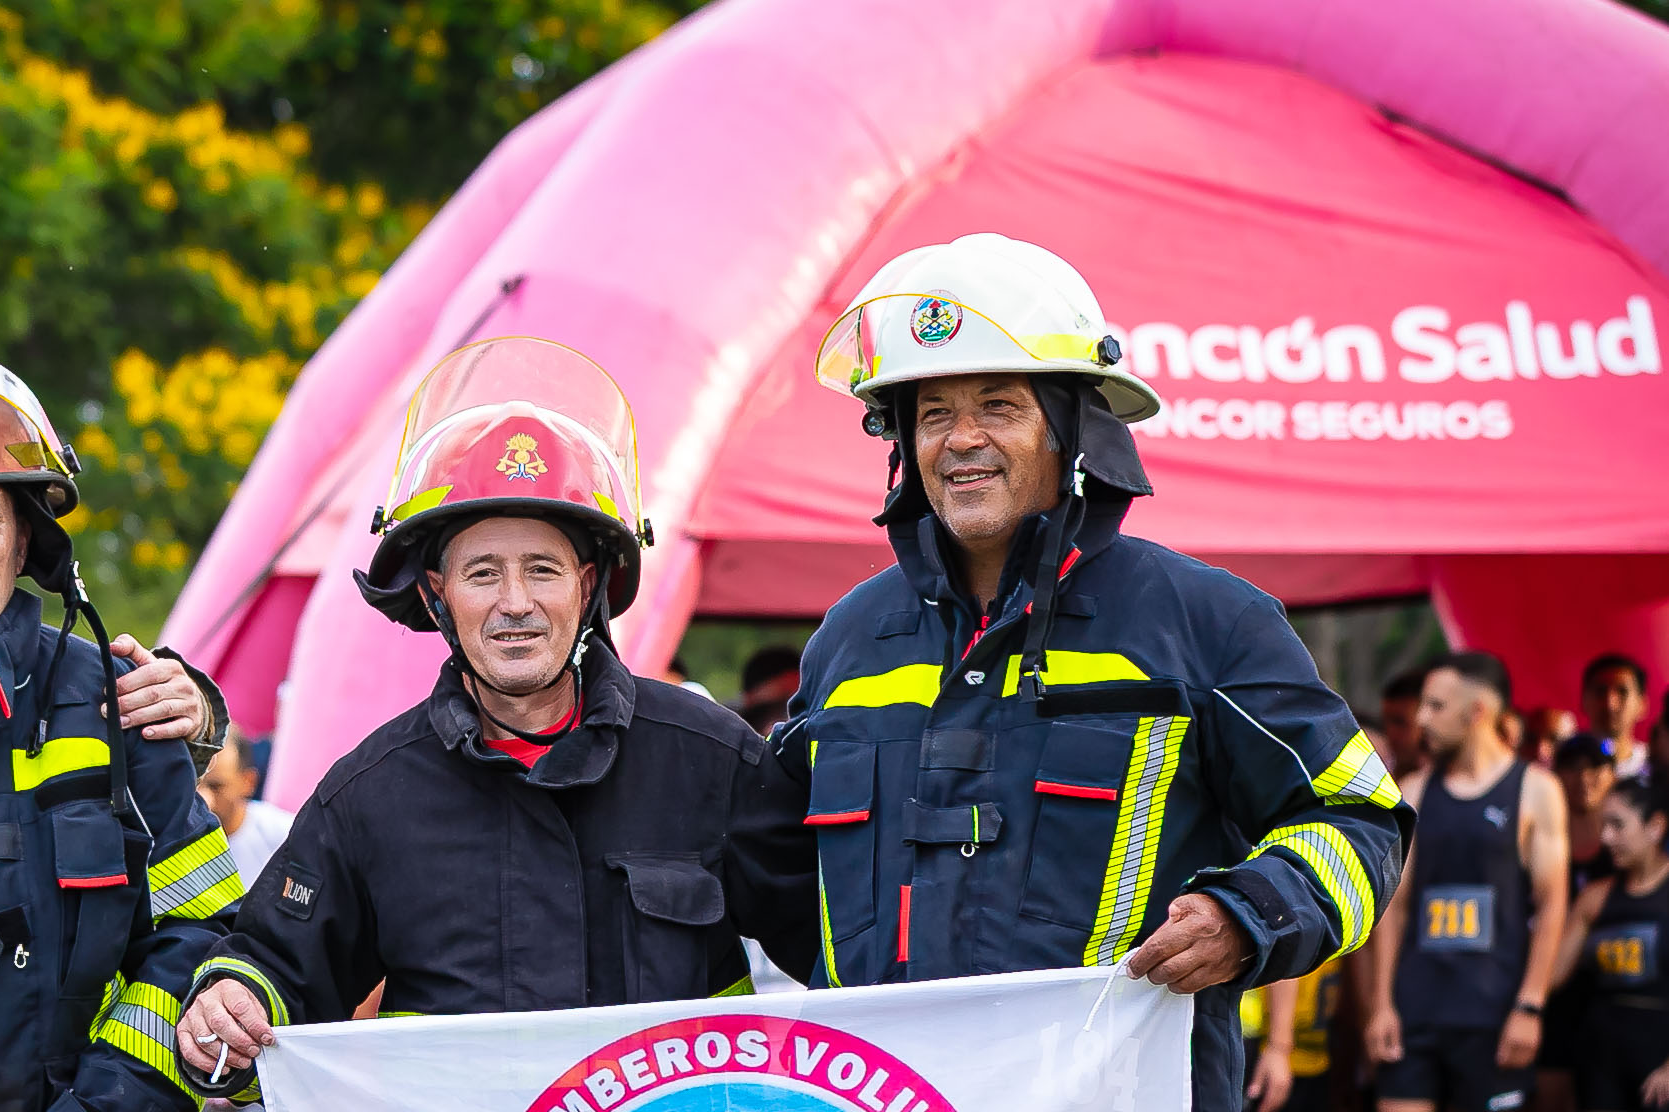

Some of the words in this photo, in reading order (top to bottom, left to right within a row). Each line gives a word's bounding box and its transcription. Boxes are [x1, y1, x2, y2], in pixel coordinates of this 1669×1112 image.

[1105, 317, 1387, 382] nción
[1392, 296, 1662, 383] Salud
[1130, 398, 1285, 440] ANCOR
[1292, 401, 1514, 441] SEGUROS
[287, 880, 314, 905] LION
